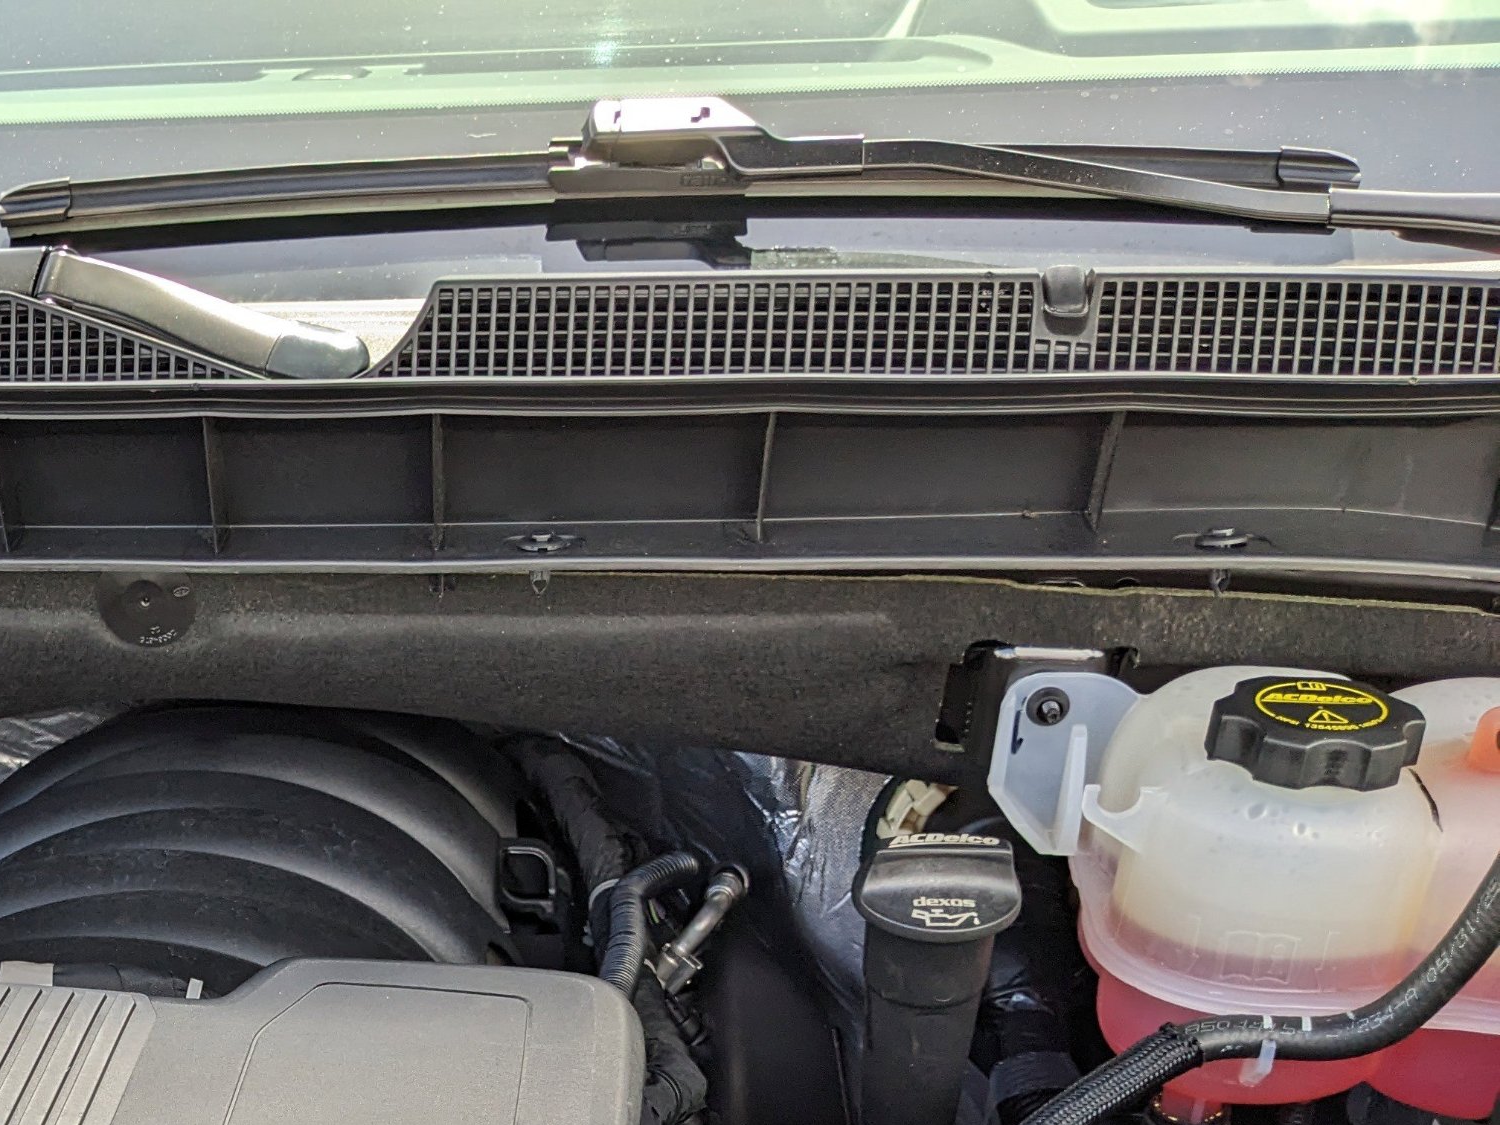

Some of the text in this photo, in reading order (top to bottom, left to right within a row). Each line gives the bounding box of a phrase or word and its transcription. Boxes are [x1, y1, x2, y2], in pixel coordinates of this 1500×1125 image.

[1261, 693, 1373, 704] ACDelco
[888, 833, 1000, 848] ACDelco
[912, 896, 977, 907] dexos
